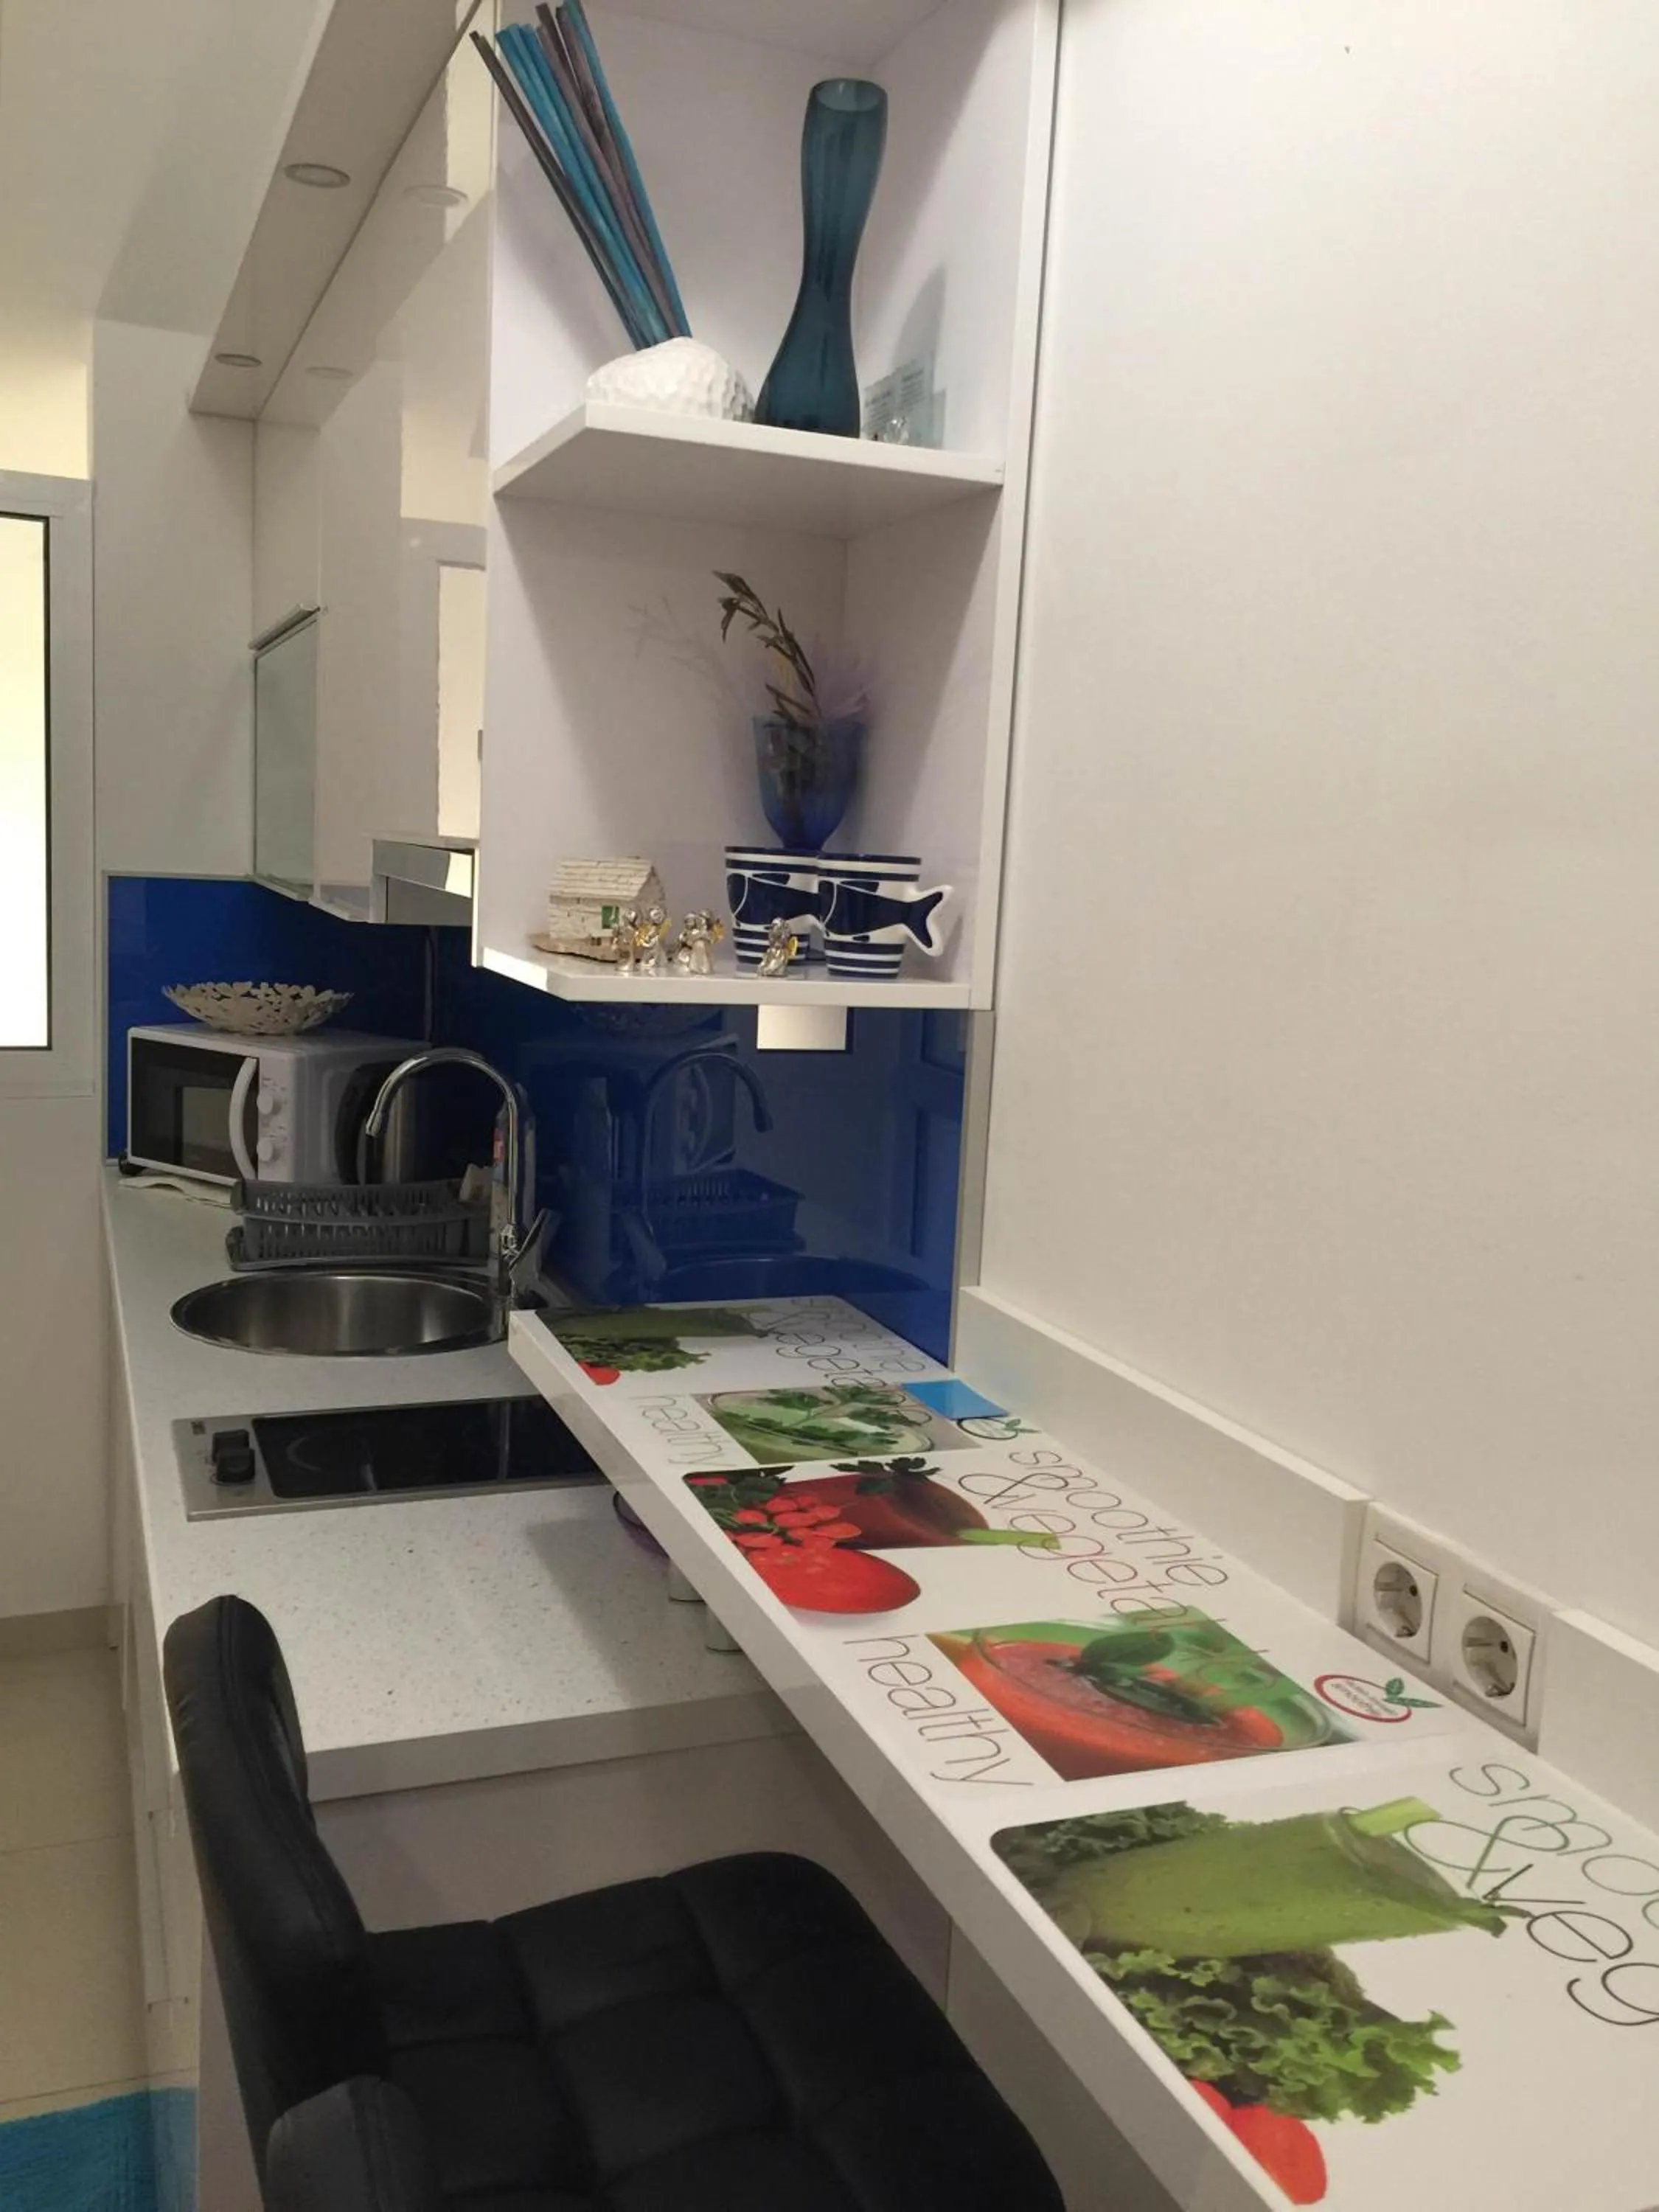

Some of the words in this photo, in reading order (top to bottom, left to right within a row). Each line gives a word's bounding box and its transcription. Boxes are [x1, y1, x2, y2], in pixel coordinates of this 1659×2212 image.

[627, 1394, 737, 1467] healthy
[958, 1472, 1069, 1505] &
[1008, 1450, 1228, 1586] smoothie
[842, 1633, 1034, 1785] healthy
[1404, 1814, 1571, 1889] &
[1449, 1764, 1659, 1929] smo
